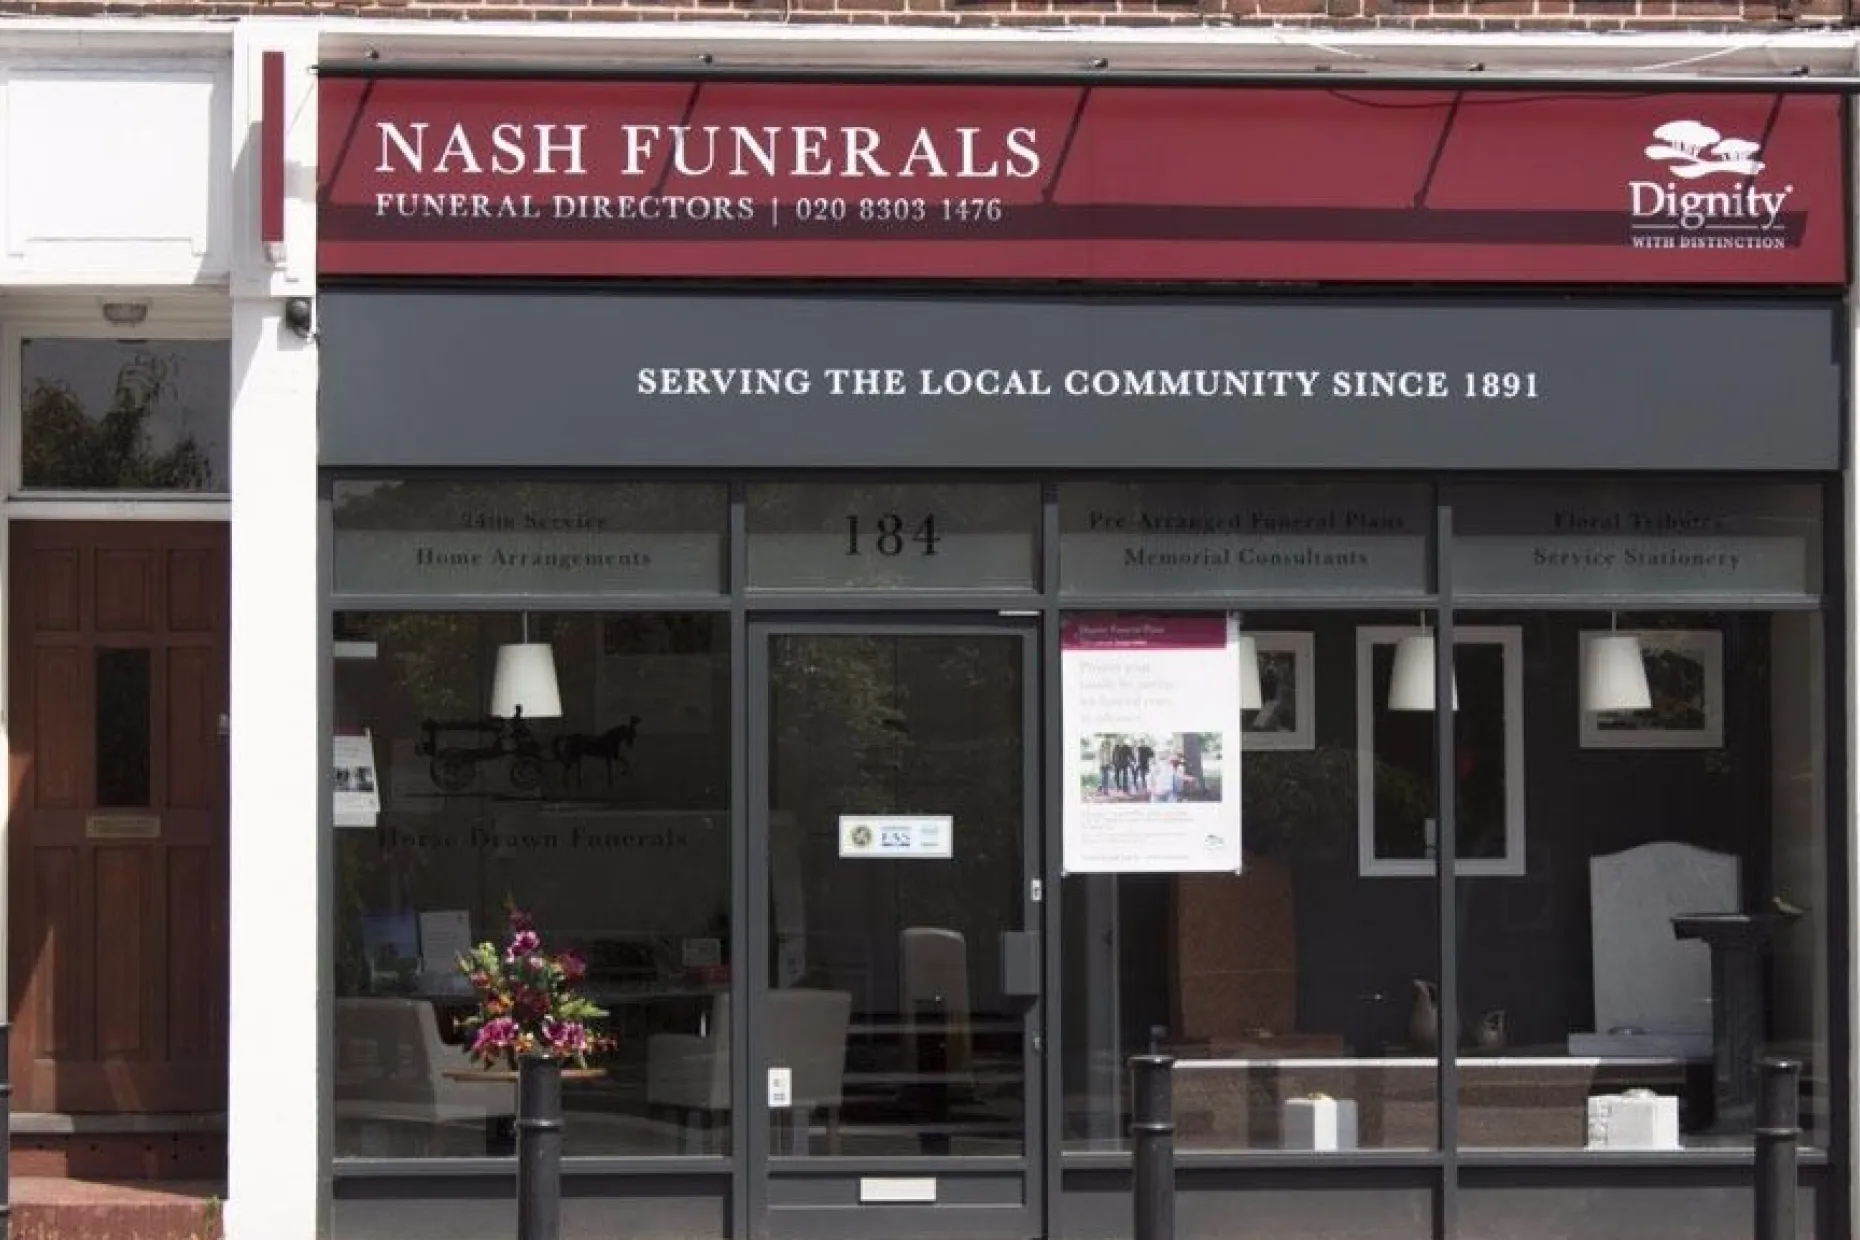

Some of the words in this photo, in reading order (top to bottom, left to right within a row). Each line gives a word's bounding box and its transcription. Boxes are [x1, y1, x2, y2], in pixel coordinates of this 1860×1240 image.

[376, 122, 588, 176] NASH
[621, 124, 1041, 179] FUNERALS
[375, 192, 540, 219] FUNERAL
[553, 194, 755, 221] DIRECTORS
[796, 197, 846, 221] 020
[859, 197, 926, 221] 8303
[942, 197, 1002, 222] 1476
[1629, 180, 1790, 229] Dignity
[1633, 236, 1675, 249] WITH
[1680, 236, 1785, 249] DISTINCTION
[638, 367, 812, 396] SERVING
[824, 369, 907, 395] THE
[920, 369, 1051, 396] LOCAL
[1064, 369, 1321, 397] COMMUNITY
[1333, 370, 1449, 397] SINCE
[1465, 371, 1539, 398] 1891
[1251, 510, 1335, 530] Funeral
[1345, 510, 1405, 530] Plans
[1554, 510, 1621, 530] Floral
[844, 513, 942, 557] 184
[416, 546, 483, 567] Home
[491, 546, 652, 571] Arrangements
[1124, 547, 1231, 567] Memorial
[1238, 547, 1369, 567] Consultants
[1533, 547, 1616, 567] Service
[1624, 547, 1740, 570] Stationery
[469, 826, 558, 849] Drawn
[571, 825, 688, 849] Funerals
